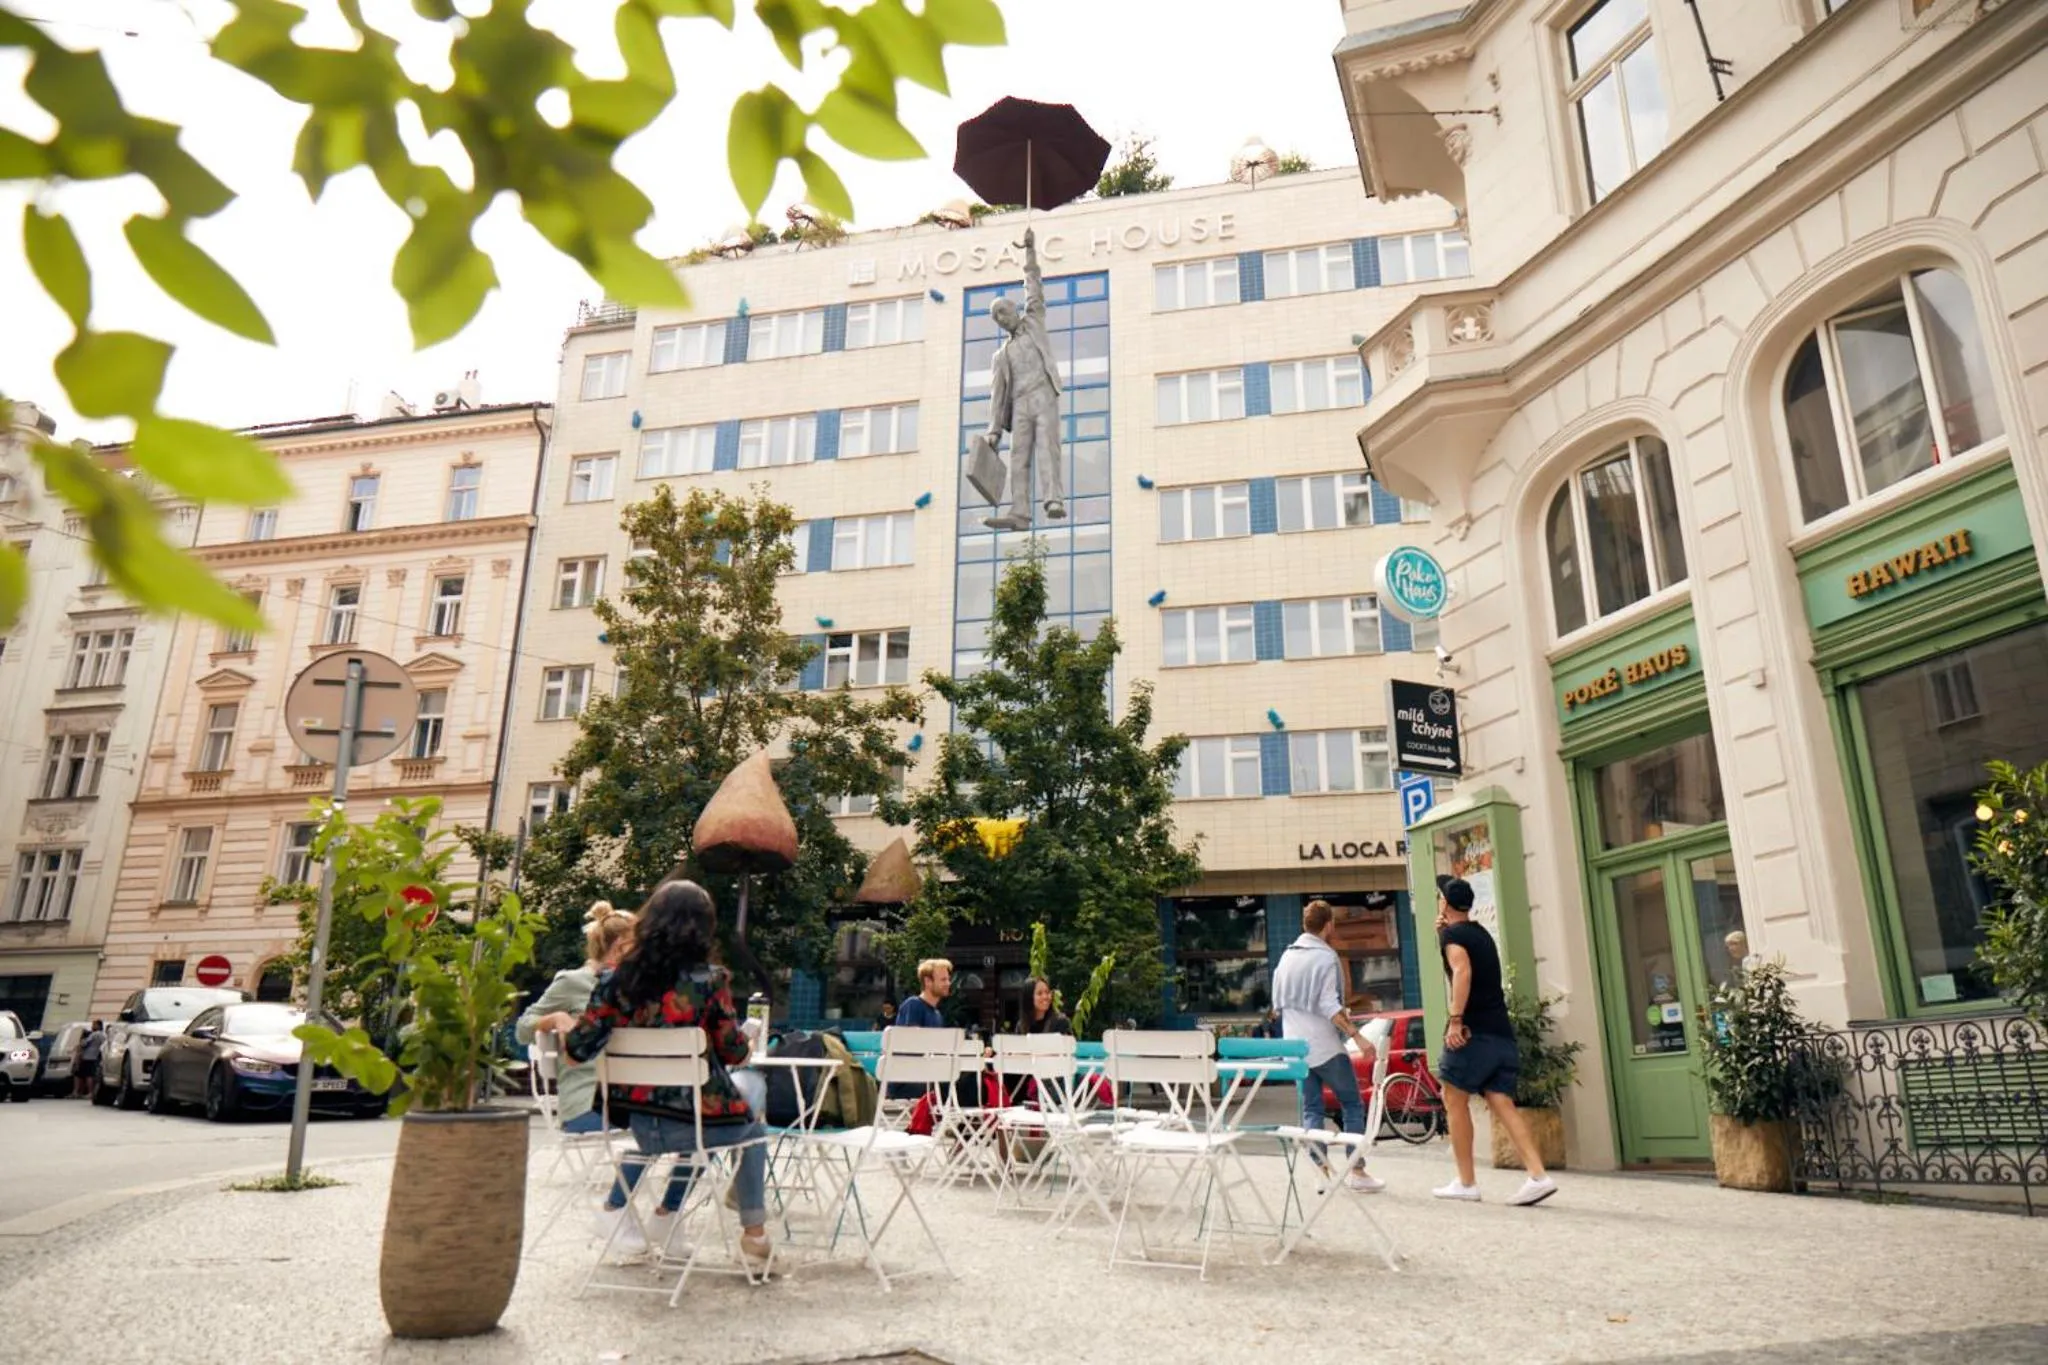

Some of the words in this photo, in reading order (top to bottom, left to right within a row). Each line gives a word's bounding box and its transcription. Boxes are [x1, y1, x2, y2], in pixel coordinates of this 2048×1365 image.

[898, 235, 1065, 283] MOSAC
[1090, 213, 1235, 256] HOUSE
[1845, 528, 1972, 599] HAWAII
[1563, 666, 1621, 713] POKÉ
[1625, 644, 1690, 686] HAUS
[1396, 708, 1424, 722] milá
[1407, 786, 1427, 825] P
[1298, 843, 1325, 860] LA
[1331, 841, 1389, 859] LOCA
